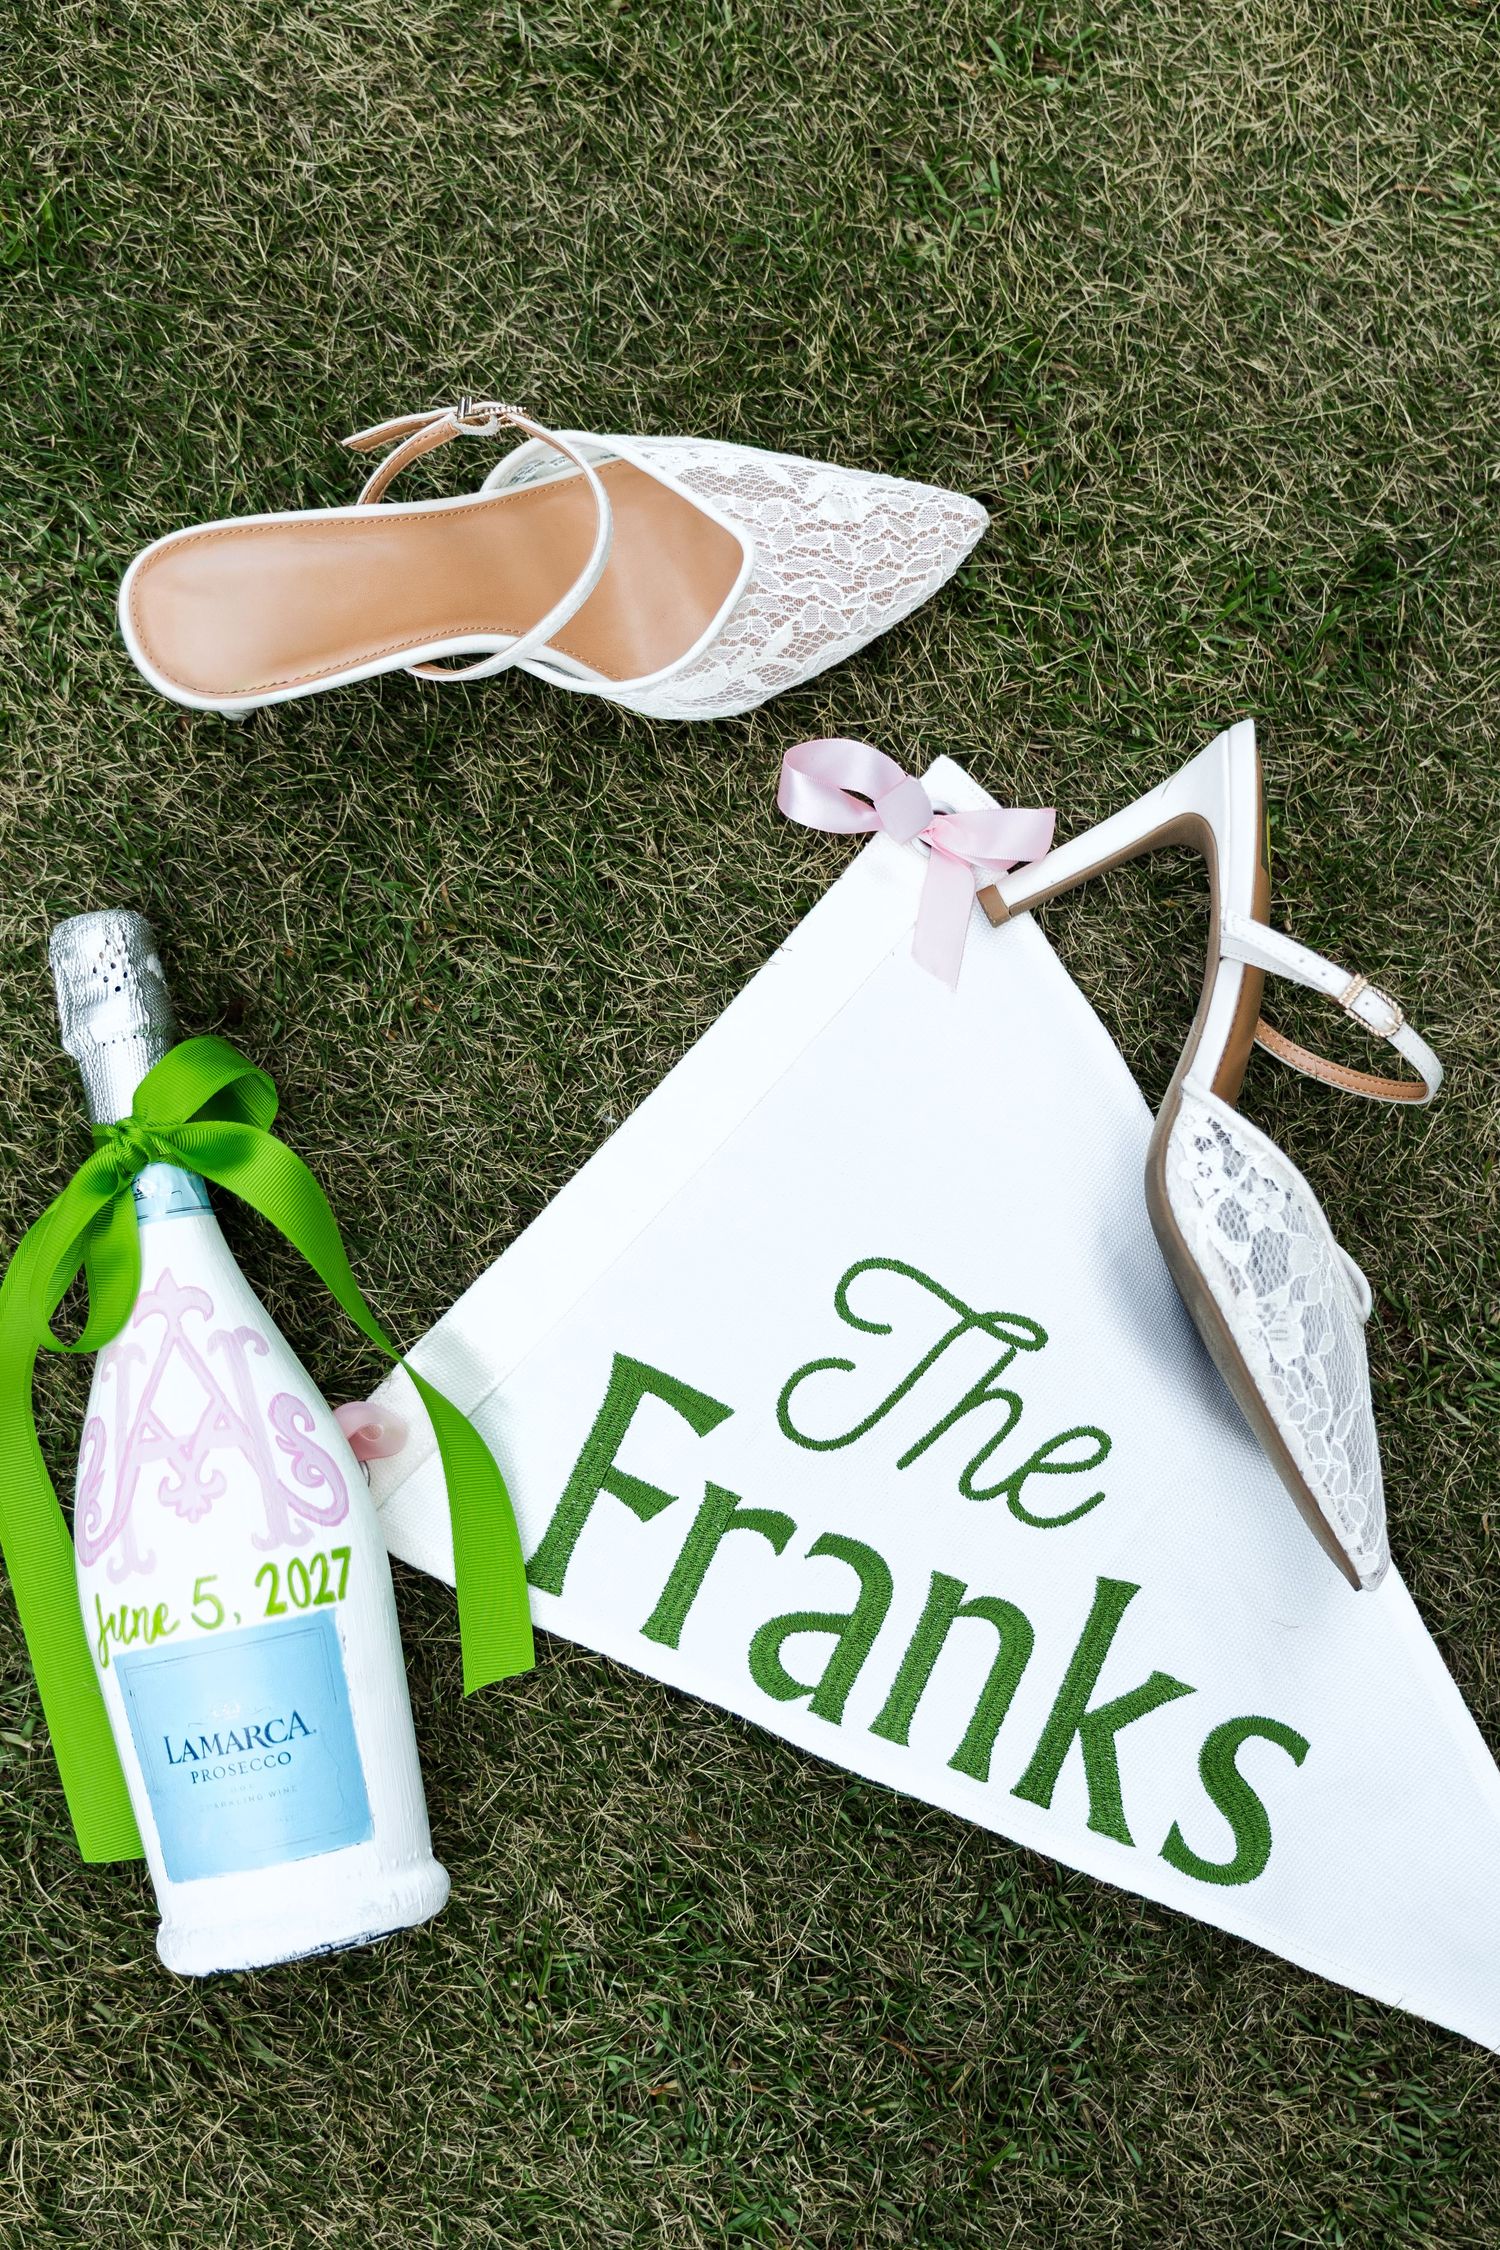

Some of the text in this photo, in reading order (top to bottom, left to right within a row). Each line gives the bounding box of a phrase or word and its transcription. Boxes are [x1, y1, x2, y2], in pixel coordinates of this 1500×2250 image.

[776, 1257, 1112, 1529] The
[95, 1546, 352, 1669] June 5, 2027
[526, 1352, 1311, 1886] Franks
[190, 1751, 292, 1784] PROSECCO
[268, 1784, 298, 1799] WINE
